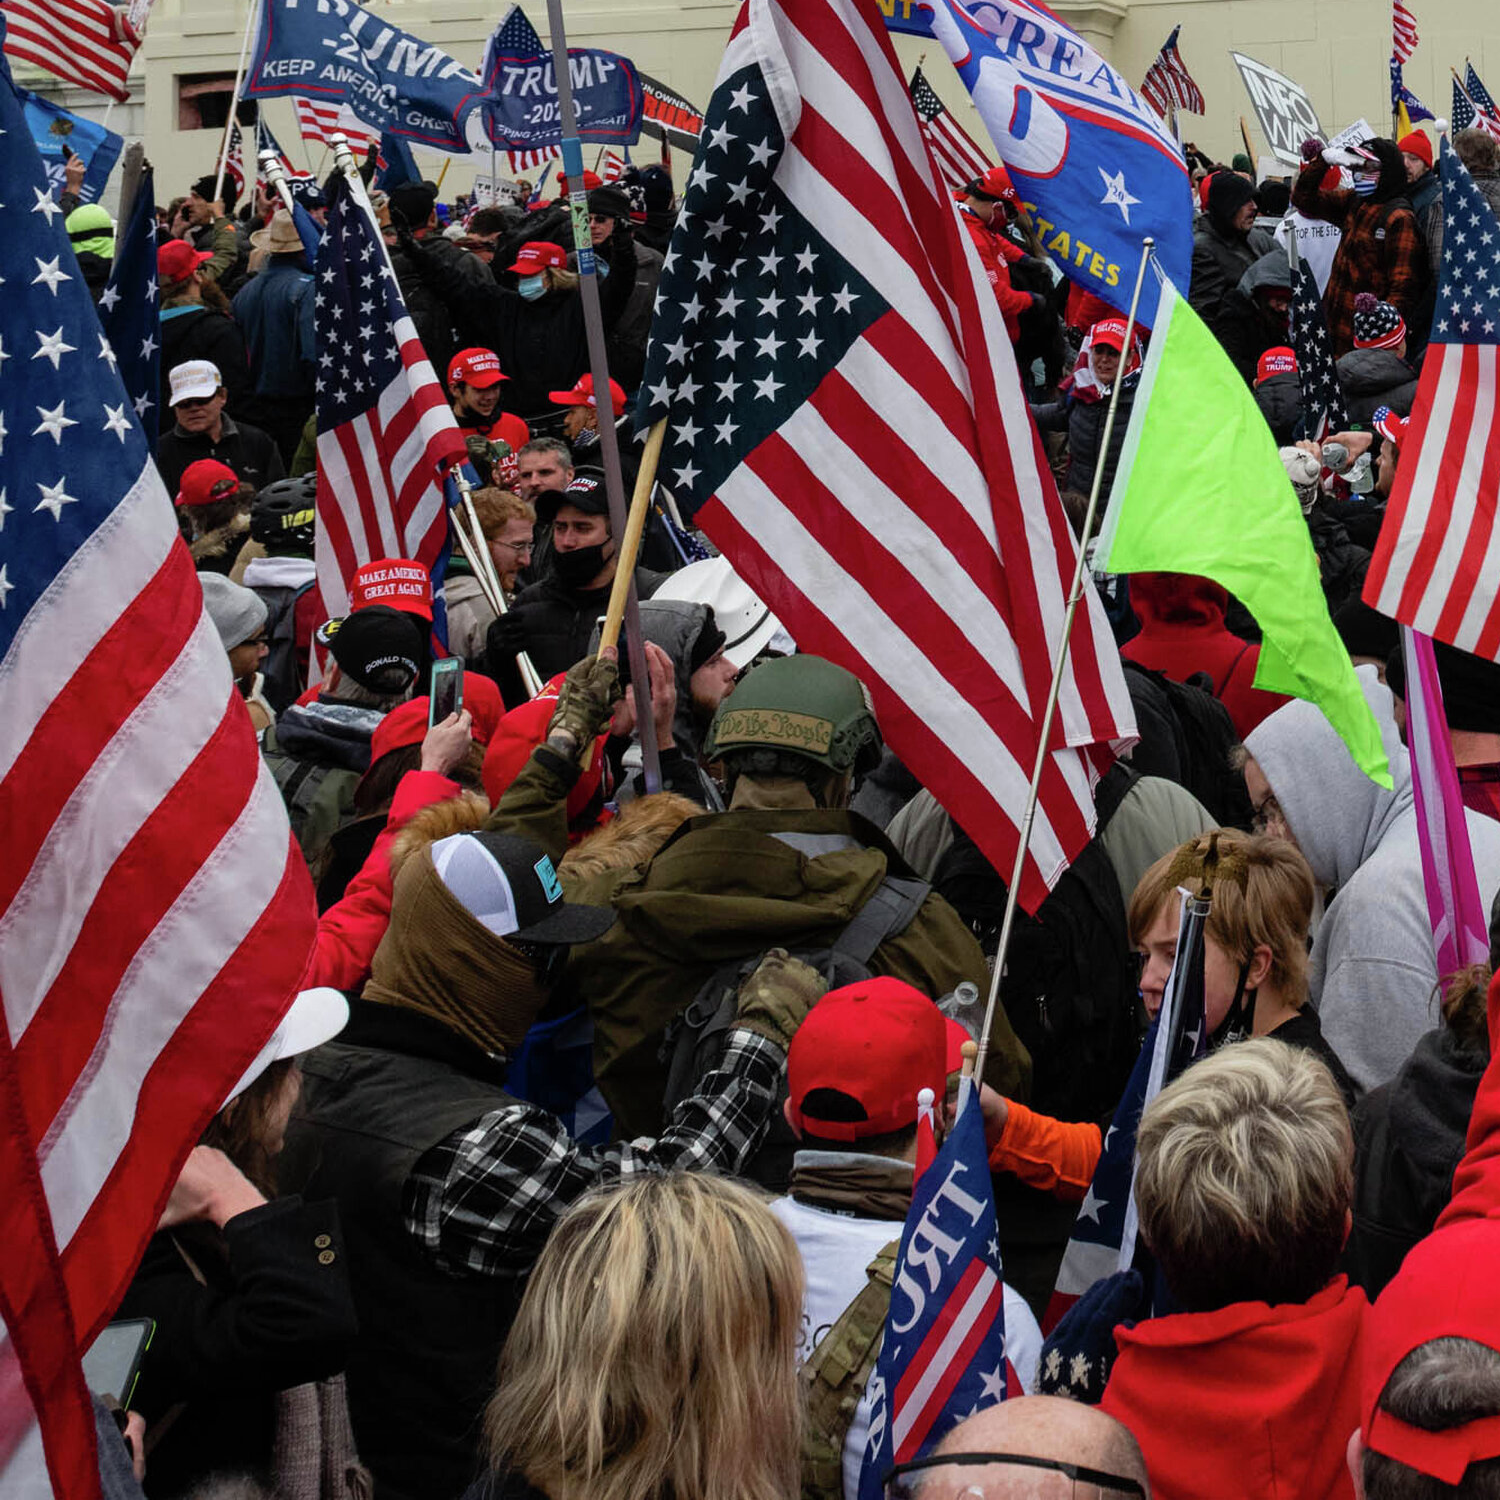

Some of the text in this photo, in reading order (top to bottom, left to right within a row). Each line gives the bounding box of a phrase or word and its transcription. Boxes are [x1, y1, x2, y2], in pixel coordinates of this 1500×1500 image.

[501, 55, 616, 98] TRUMP
[262, 59, 315, 79] KEEP
[319, 64, 400, 121] AMERICA
[1241, 66, 1320, 135] INFO
[1312, 227, 1325, 238] THE
[359, 566, 427, 586] MAKE AMERICA
[364, 583, 424, 600] GREAT AGAIN
[364, 655, 400, 674] DONALD
